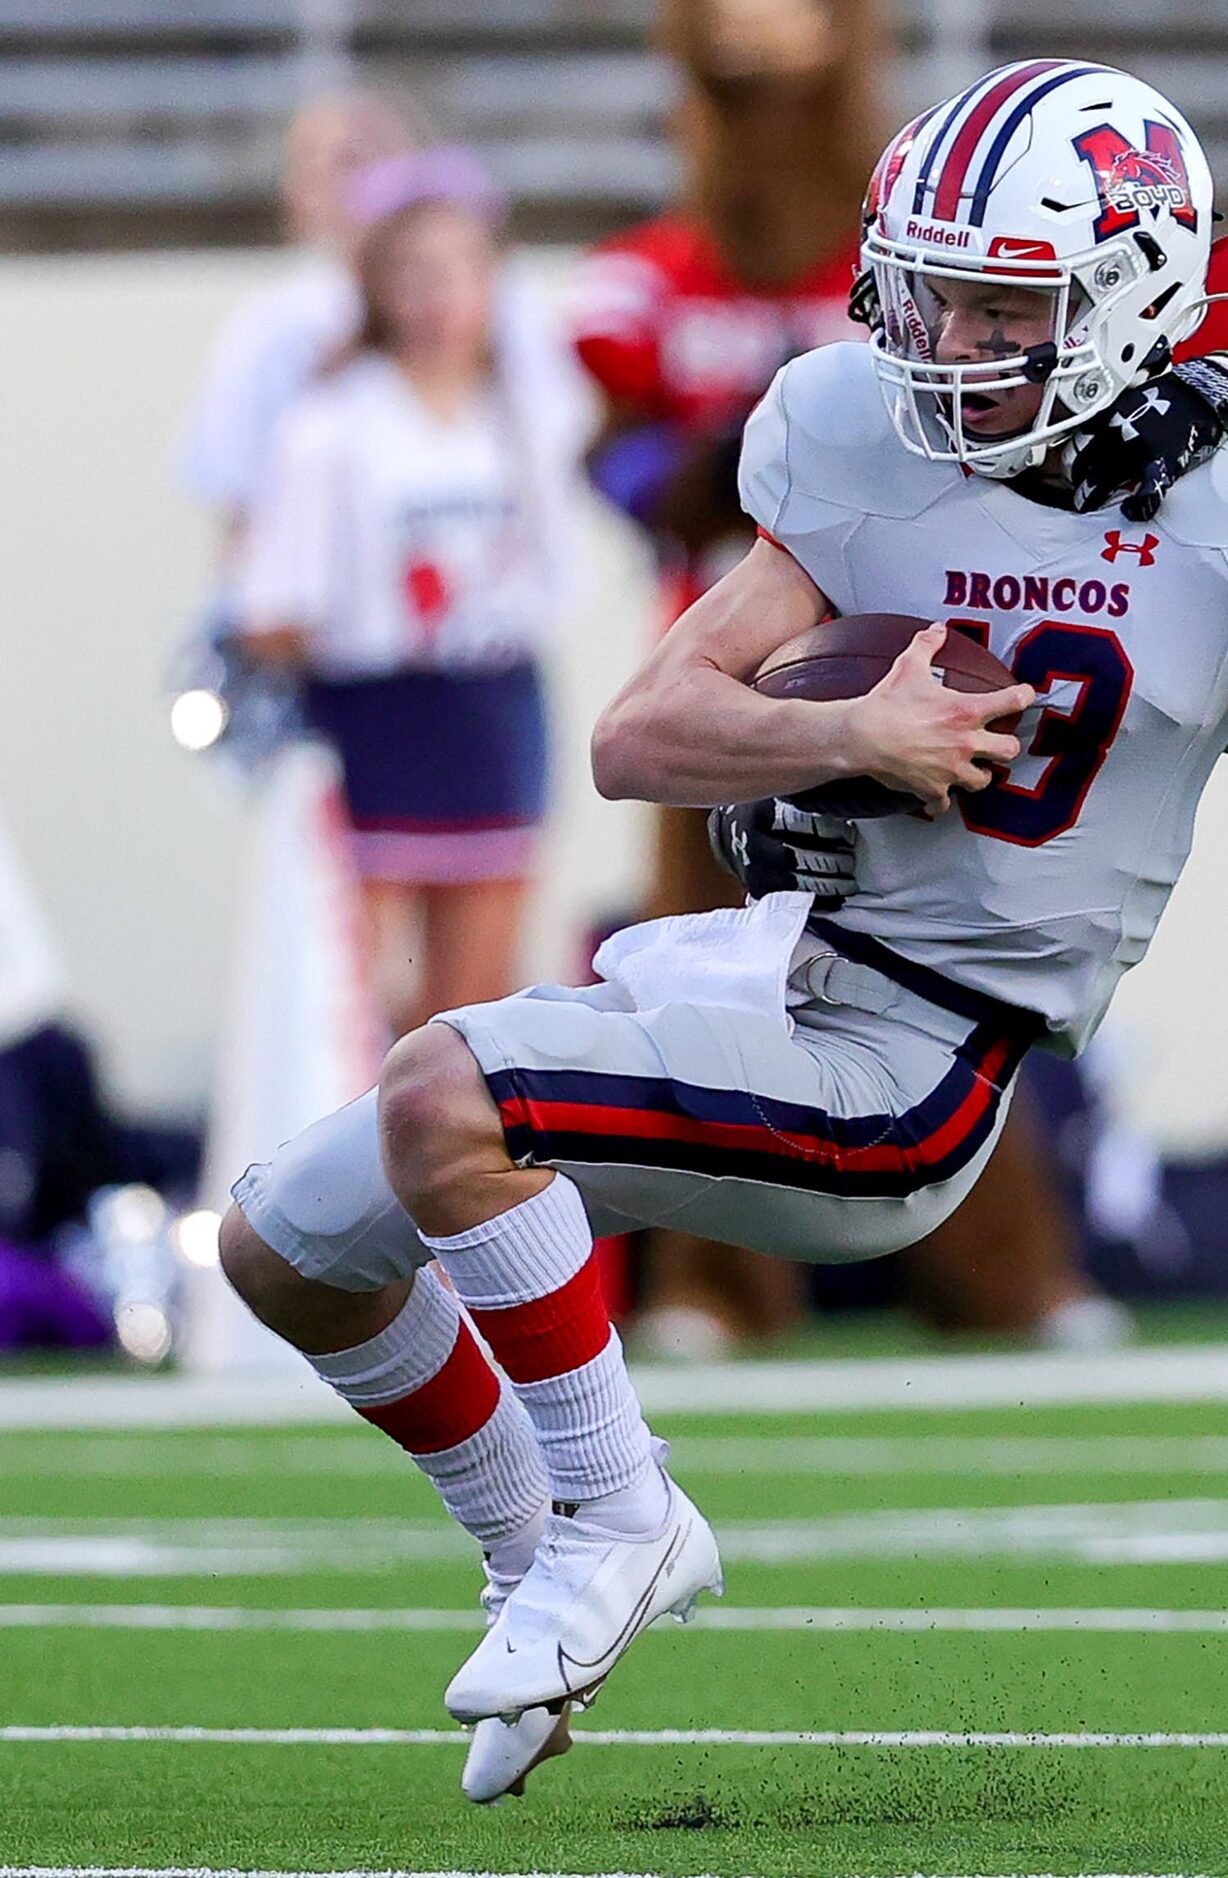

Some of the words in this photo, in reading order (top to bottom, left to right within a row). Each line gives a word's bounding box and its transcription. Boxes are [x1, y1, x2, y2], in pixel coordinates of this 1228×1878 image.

[1110, 187, 1184, 212] BOYD
[907, 220, 970, 248] Riddell
[903, 299, 932, 359] Riddell
[943, 570, 1130, 617] BRONCOS
[946, 618, 1134, 848] 3
